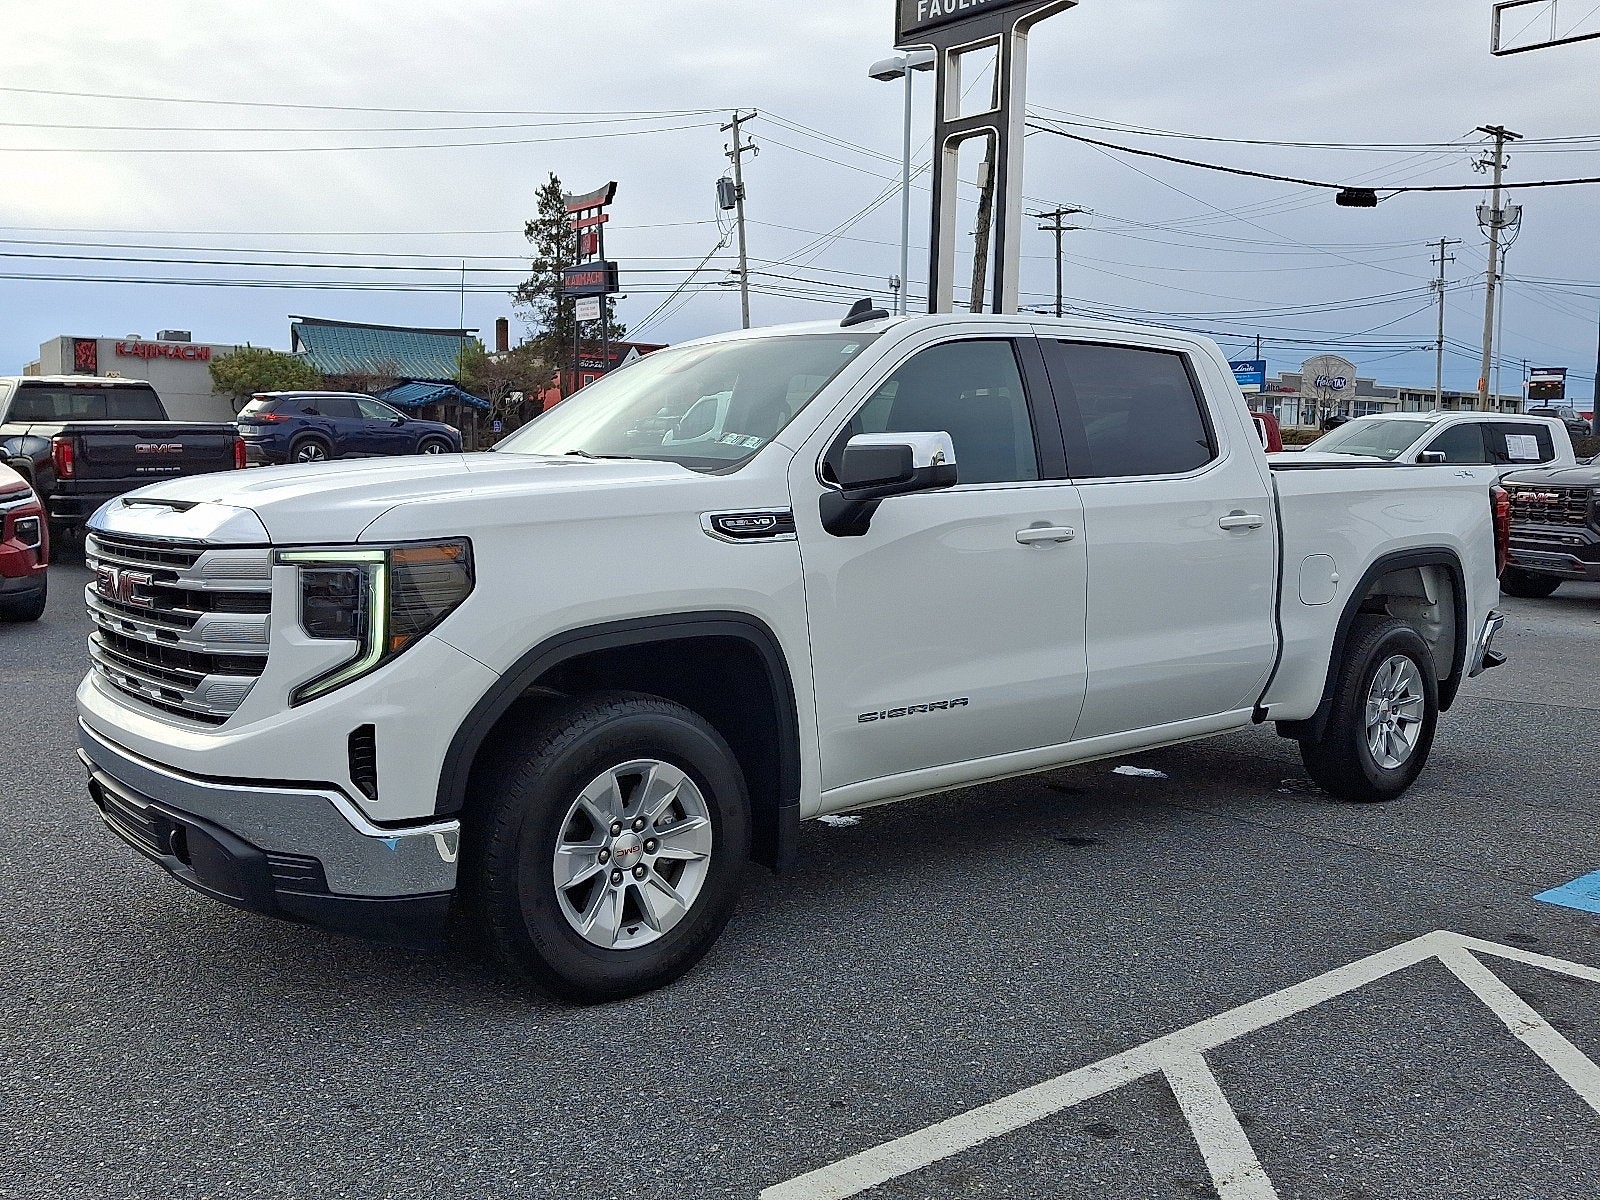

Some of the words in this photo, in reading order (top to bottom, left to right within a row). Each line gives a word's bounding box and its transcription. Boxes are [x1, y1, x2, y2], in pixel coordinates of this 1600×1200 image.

[116, 341, 211, 361] KAJIMACHI
[1334, 378, 1346, 388] TAX
[135, 444, 183, 453] GMC
[1517, 491, 1559, 503] GMC
[97, 565, 154, 609] GMC
[857, 697, 969, 723] SIERRA
[616, 845, 640, 857] GMC
